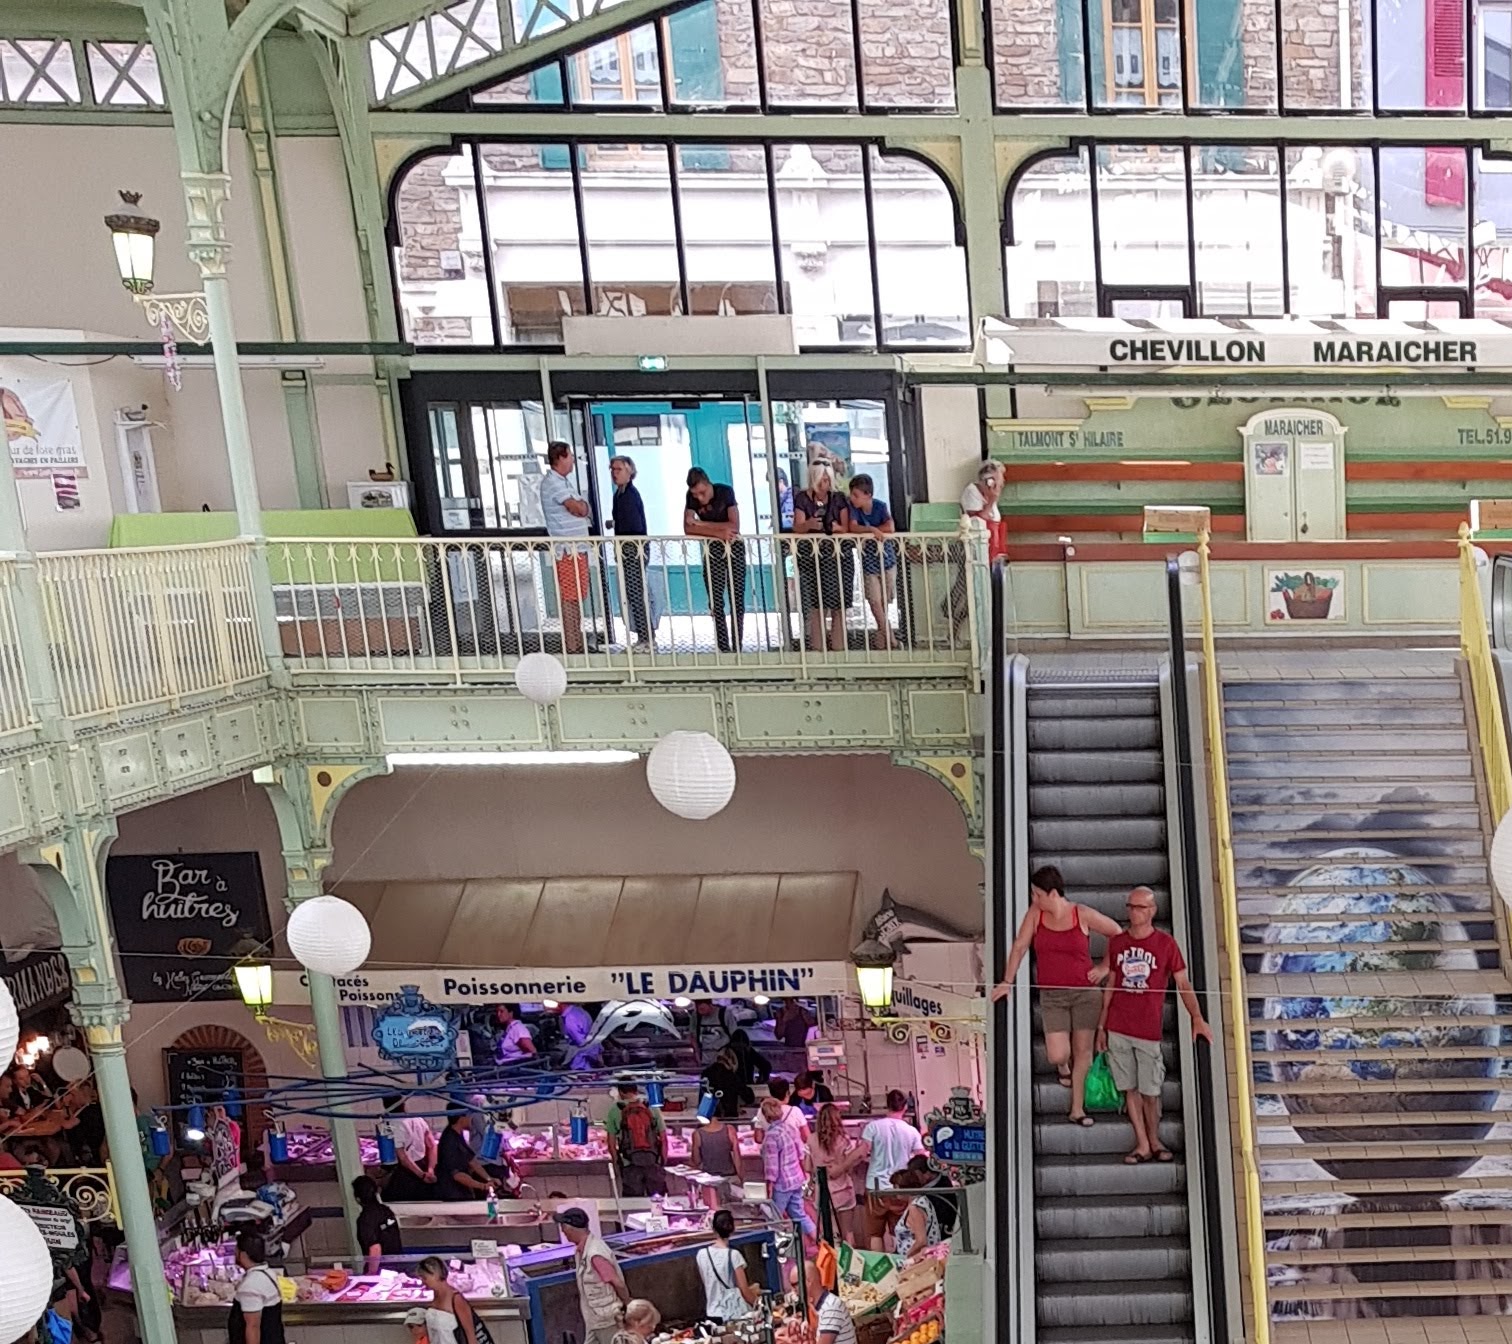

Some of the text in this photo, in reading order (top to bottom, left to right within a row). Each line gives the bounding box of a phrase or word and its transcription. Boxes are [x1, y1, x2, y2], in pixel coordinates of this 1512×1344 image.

[1109, 339, 1478, 363] CHEVILLON MARAICHER
[1264, 420, 1323, 436] MARAICHER
[1018, 431, 1063, 448] TALMONT
[1083, 431, 1124, 448] HILAIRE
[152, 860, 228, 893] Bar à
[141, 893, 240, 927] huîtres
[299, 975, 370, 987] Ctacés
[443, 976, 587, 996] Poissonnerie
